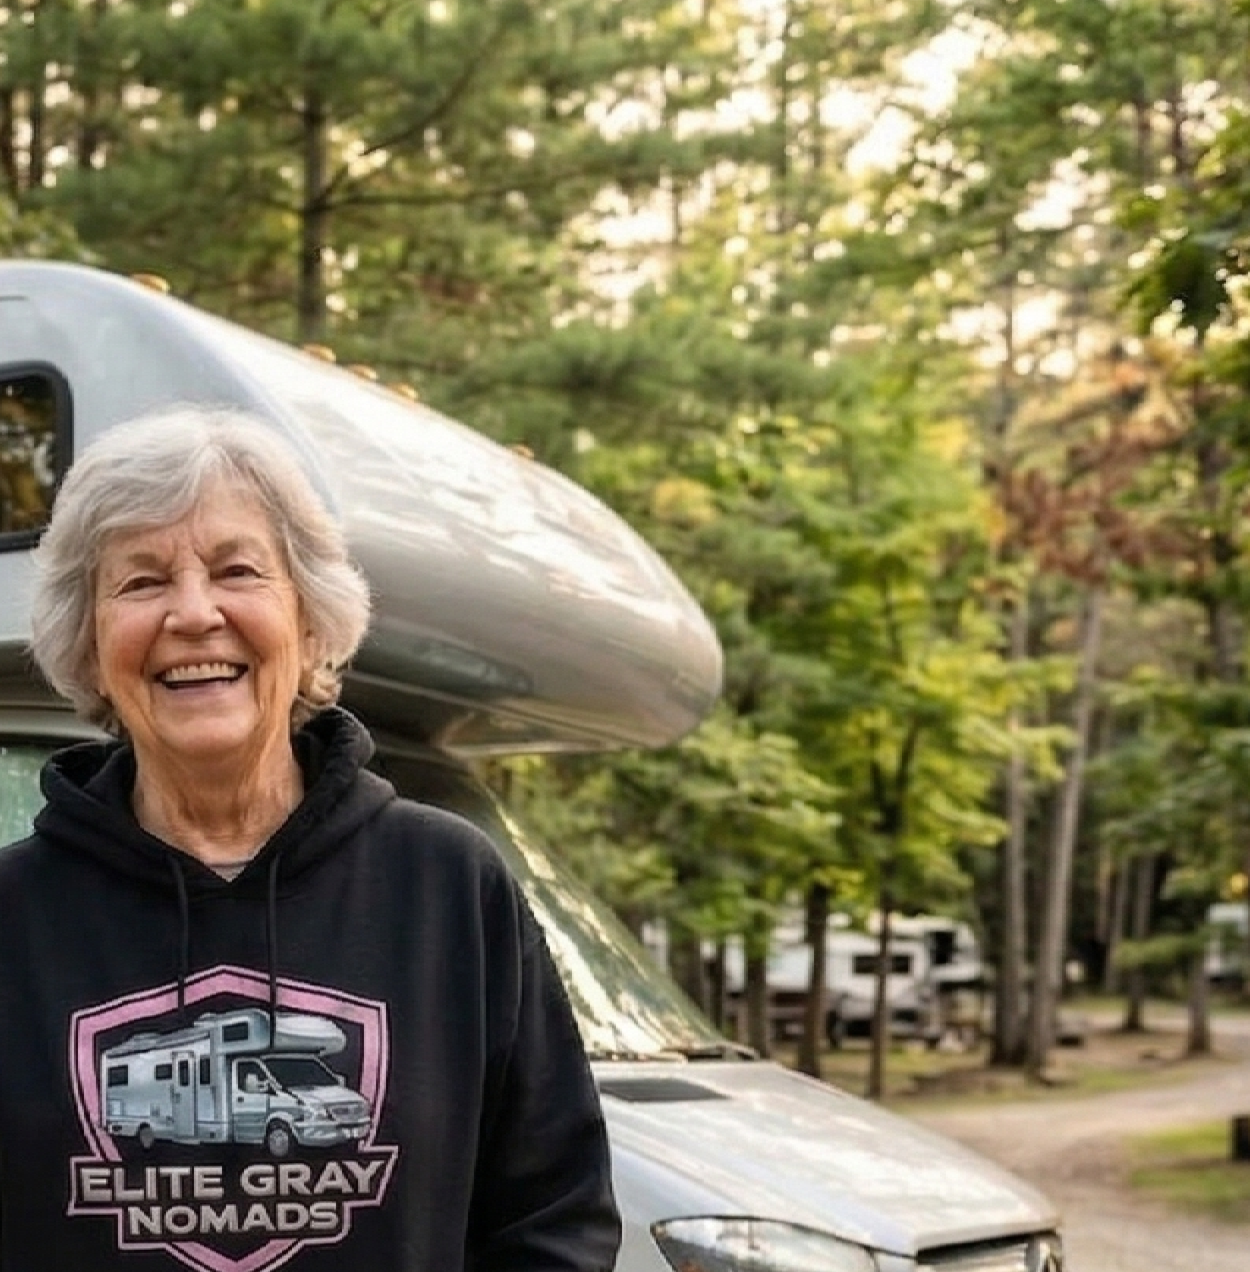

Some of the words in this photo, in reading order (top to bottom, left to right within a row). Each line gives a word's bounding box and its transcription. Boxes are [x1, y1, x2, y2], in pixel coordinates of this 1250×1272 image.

[79, 1165, 224, 1202] ELITE
[240, 1159, 386, 1196] GRAY
[127, 1201, 339, 1236] NOMADS
